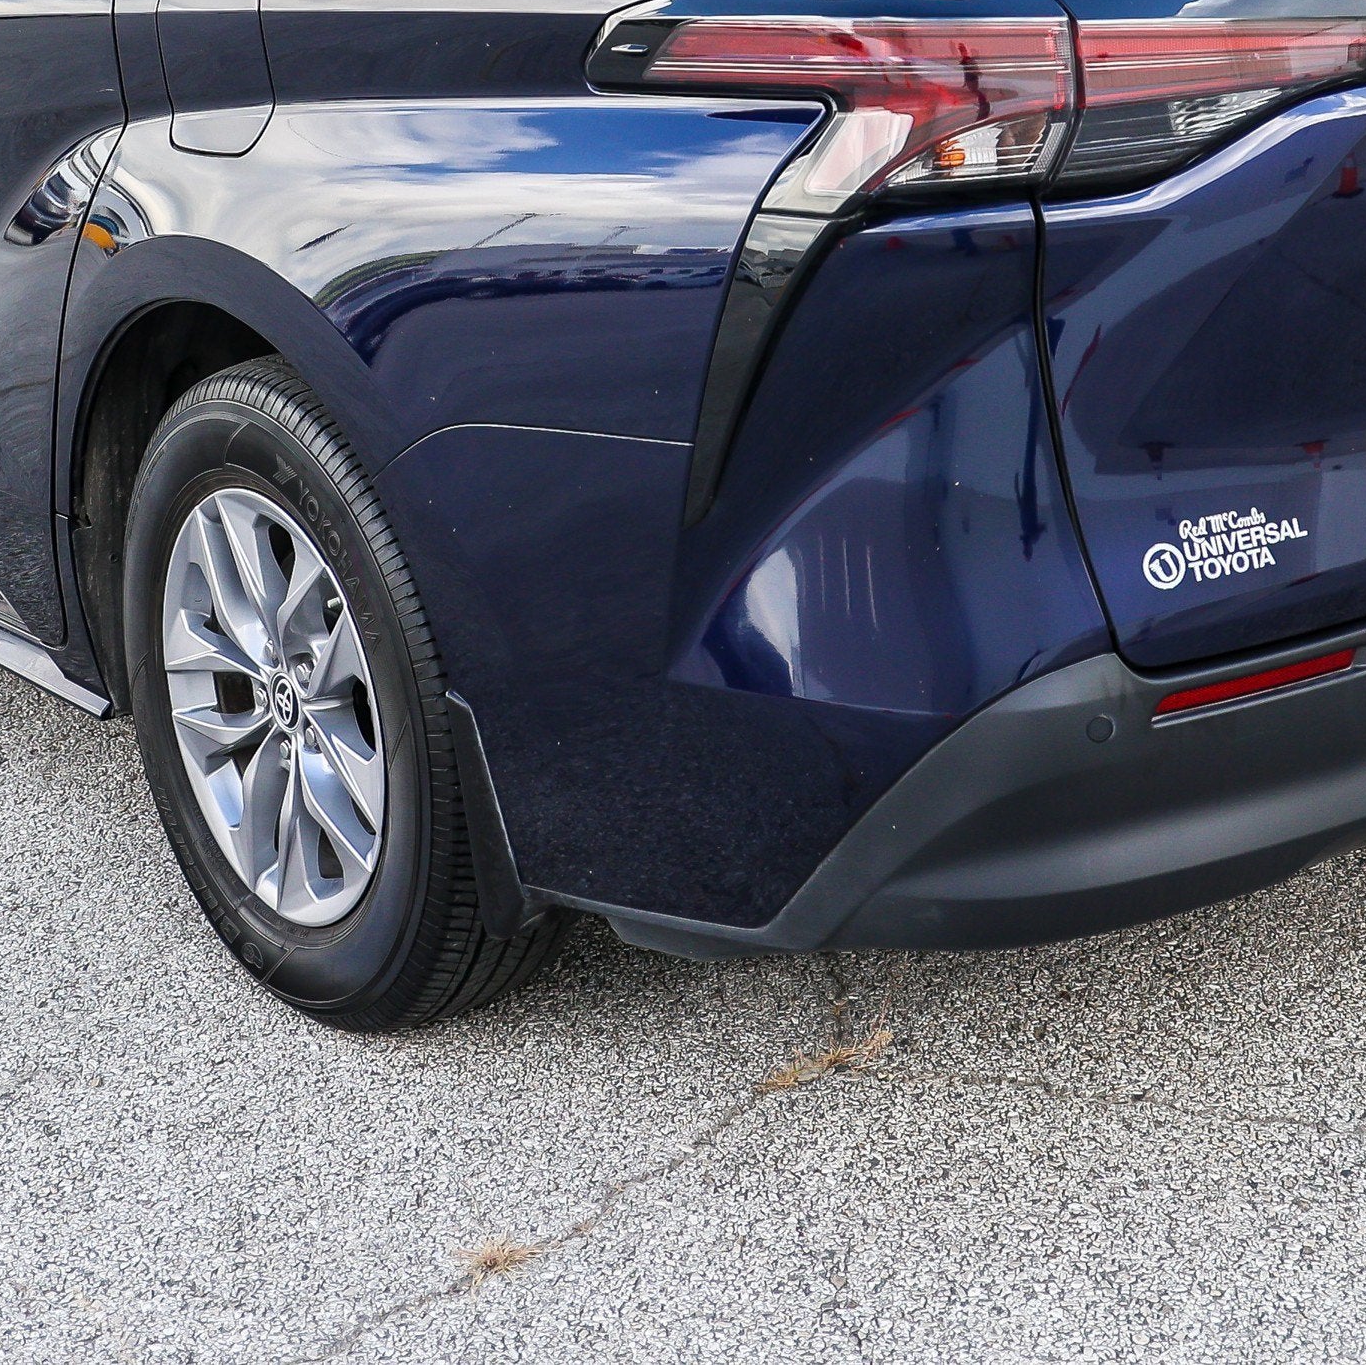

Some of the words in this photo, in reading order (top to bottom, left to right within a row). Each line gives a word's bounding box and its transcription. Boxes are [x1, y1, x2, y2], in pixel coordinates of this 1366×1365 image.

[1178, 517, 1209, 543] Red
[1206, 506, 1267, 534] McCombs
[1182, 517, 1309, 562] UNIVERSAL
[297, 478, 383, 655] YOKOHAMA
[1188, 547, 1277, 583] TOYOTA
